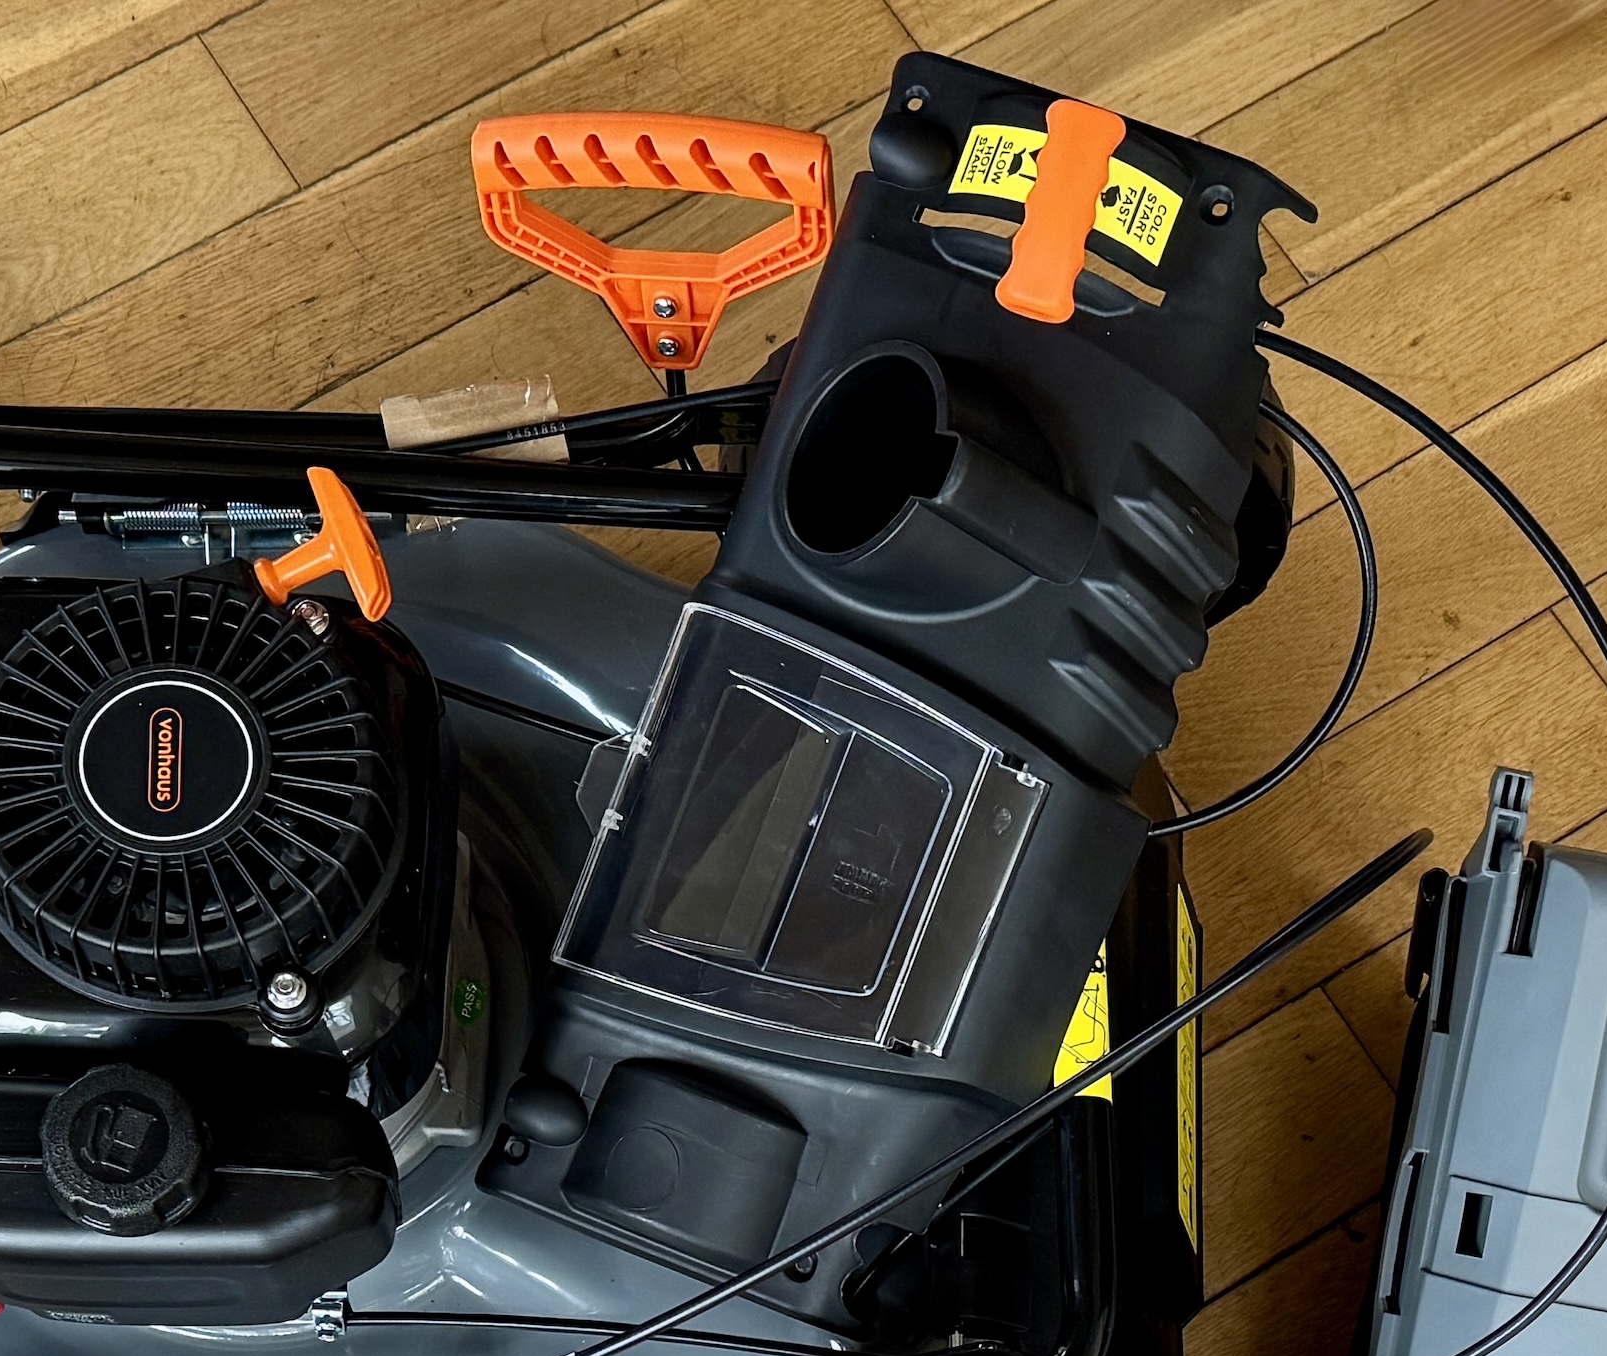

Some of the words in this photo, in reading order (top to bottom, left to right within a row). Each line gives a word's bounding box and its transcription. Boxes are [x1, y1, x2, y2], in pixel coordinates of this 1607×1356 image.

[966, 137, 988, 183] START
[978, 146, 994, 175] HOT
[991, 141, 1013, 184] SLOW
[1116, 187, 1138, 227] FAST
[1134, 193, 1157, 243] START
[1146, 204, 1167, 246] COLD
[156, 717, 176, 802] vonhaus
[461, 982, 478, 1018] PASS
